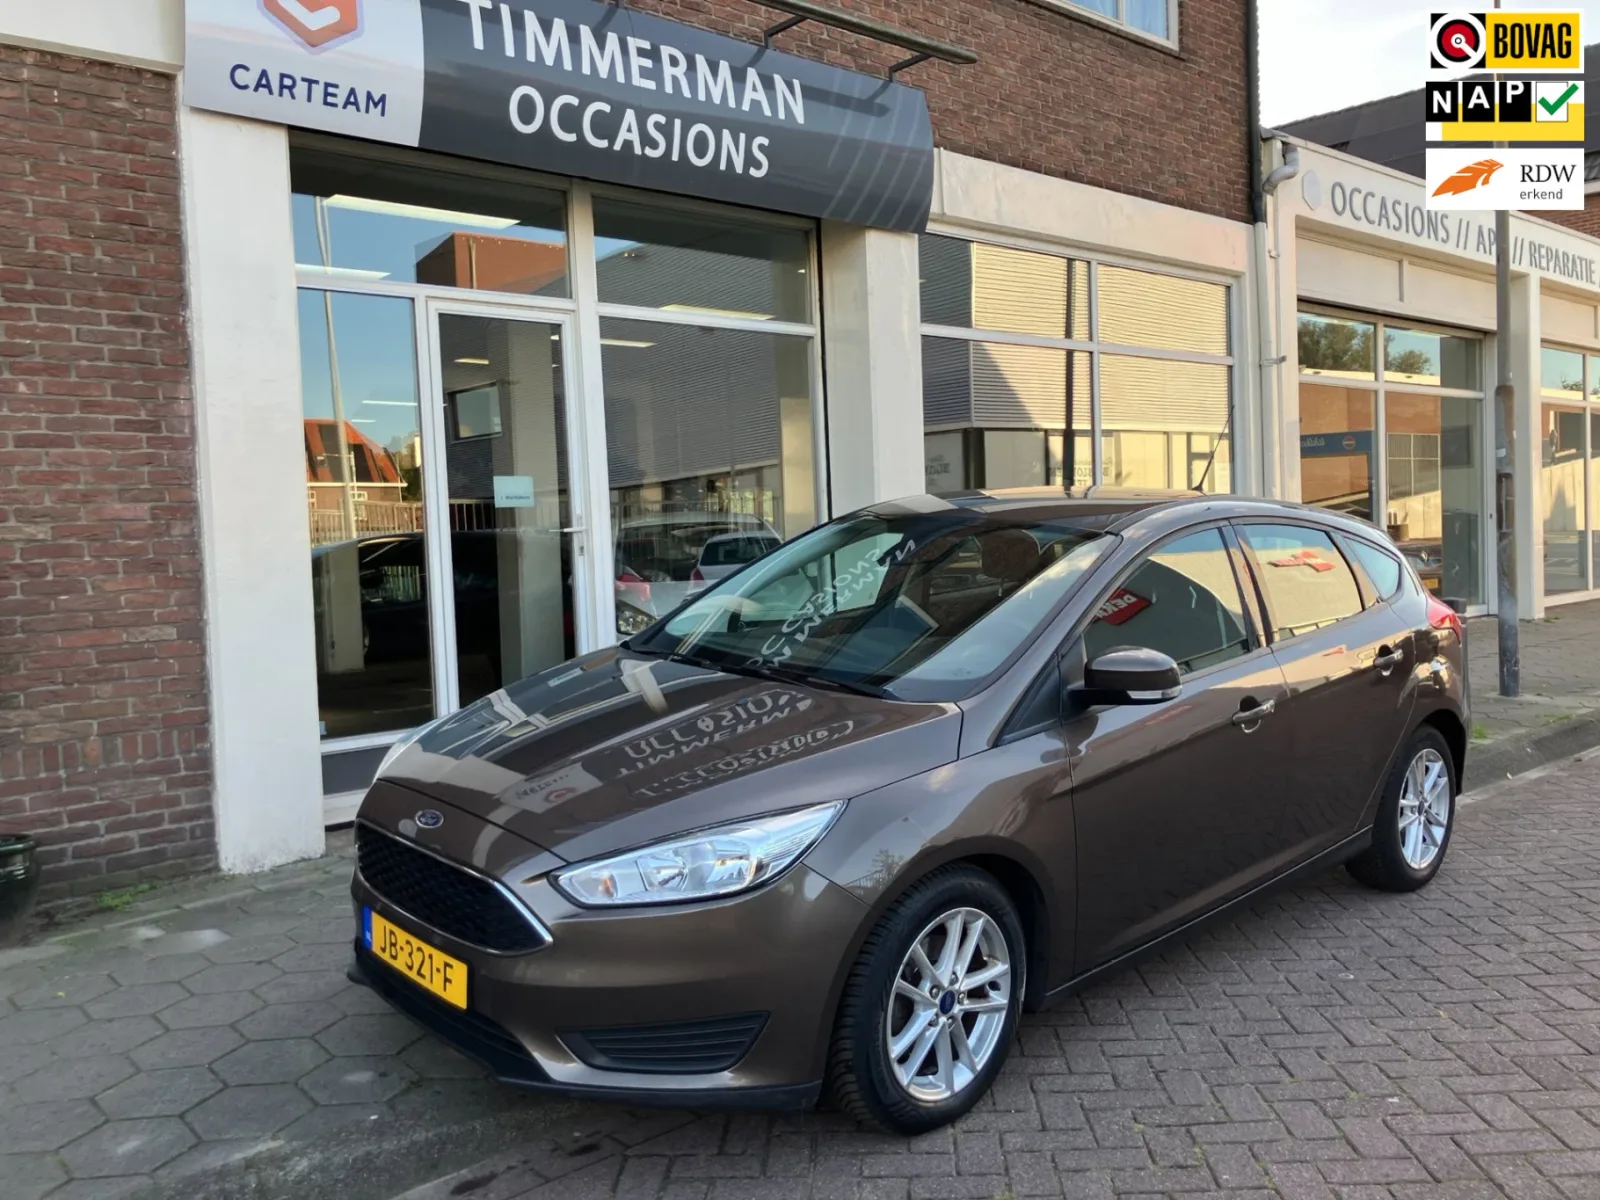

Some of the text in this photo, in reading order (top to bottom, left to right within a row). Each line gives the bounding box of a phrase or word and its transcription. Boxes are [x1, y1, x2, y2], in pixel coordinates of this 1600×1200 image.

[229, 63, 387, 117] CARTEAM
[455, 0, 805, 125] TIMMERMAN
[509, 85, 770, 178] OCCASIONS
[1331, 181, 1449, 244] OCCASIONS
[1528, 240, 1596, 285] REPARATIE
[380, 925, 454, 993] JB-321-F
